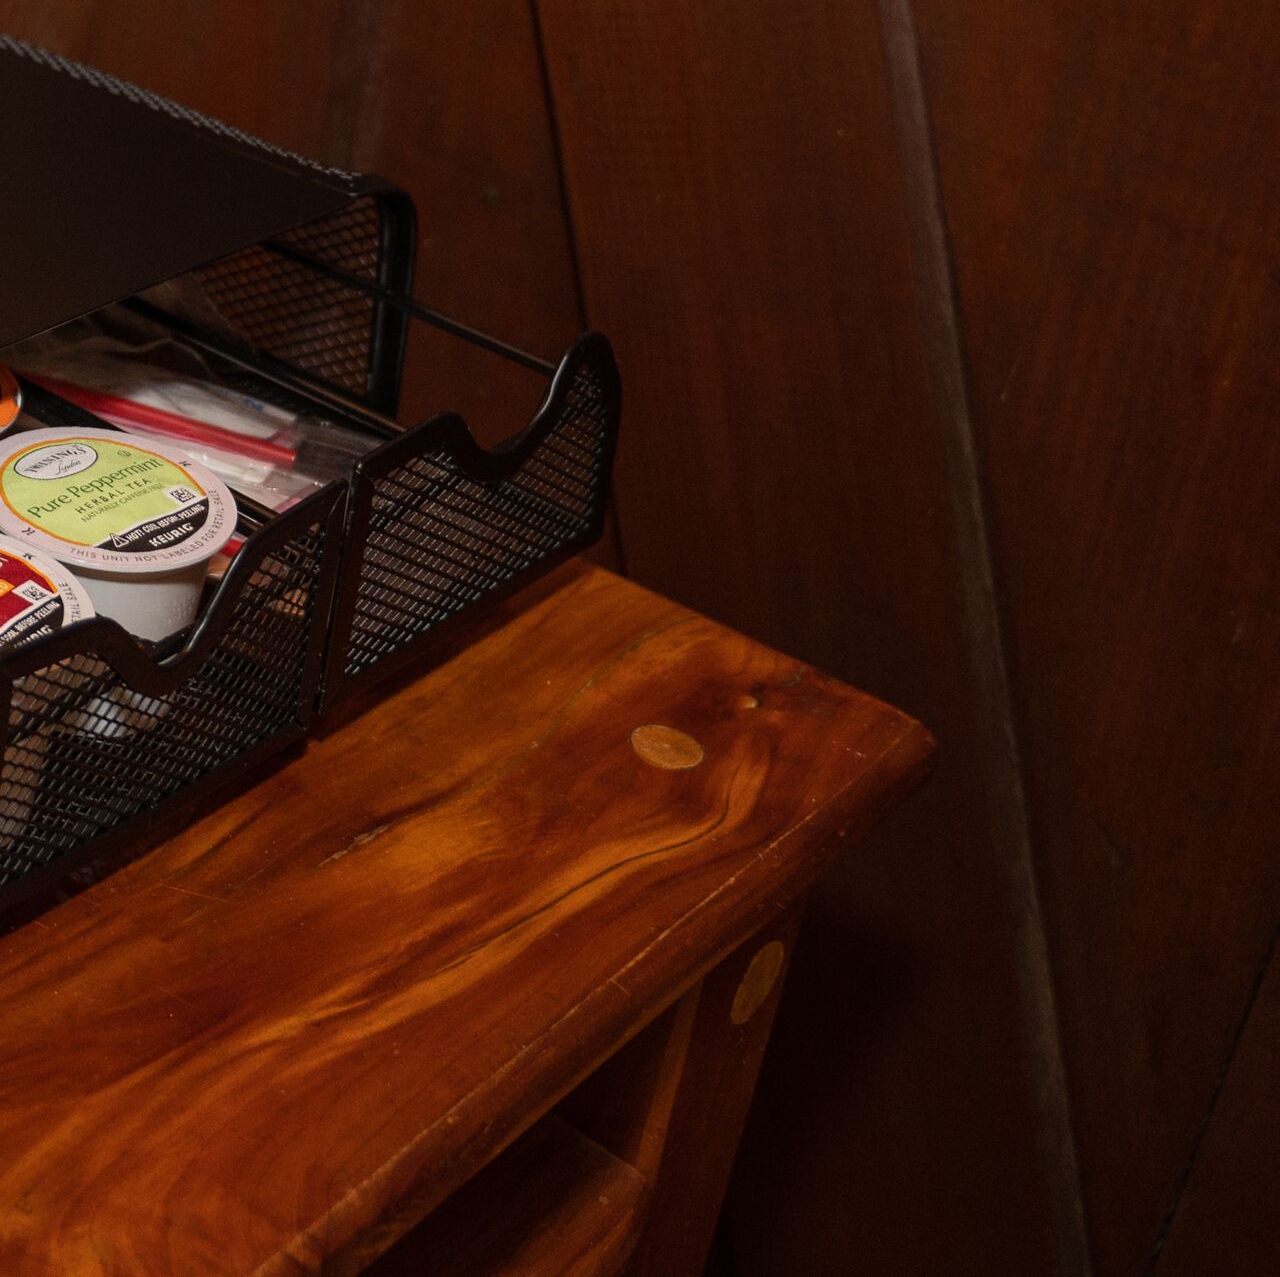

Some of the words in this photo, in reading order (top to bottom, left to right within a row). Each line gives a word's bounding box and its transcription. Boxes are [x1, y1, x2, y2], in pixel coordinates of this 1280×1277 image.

[27, 494, 72, 518] Pure
[66, 458, 164, 498] Peppermint
[75, 489, 125, 513] HERBAL
[126, 478, 151, 490] TEA
[81, 502, 119, 522] NATURALLY
[125, 529, 144, 542] HOT!
[142, 524, 160, 533] COOL
[179, 504, 205, 520] PEELING
[70, 548, 97, 559] THIS
[102, 554, 129, 562] UNIT
[161, 541, 204, 561] LABELED
[203, 529, 215, 542] FOR
[211, 507, 225, 532] RETAIL
[148, 522, 194, 547] KEURIG
[58, 581, 77, 602] SALE
[34, 600, 60, 620] PEELING
